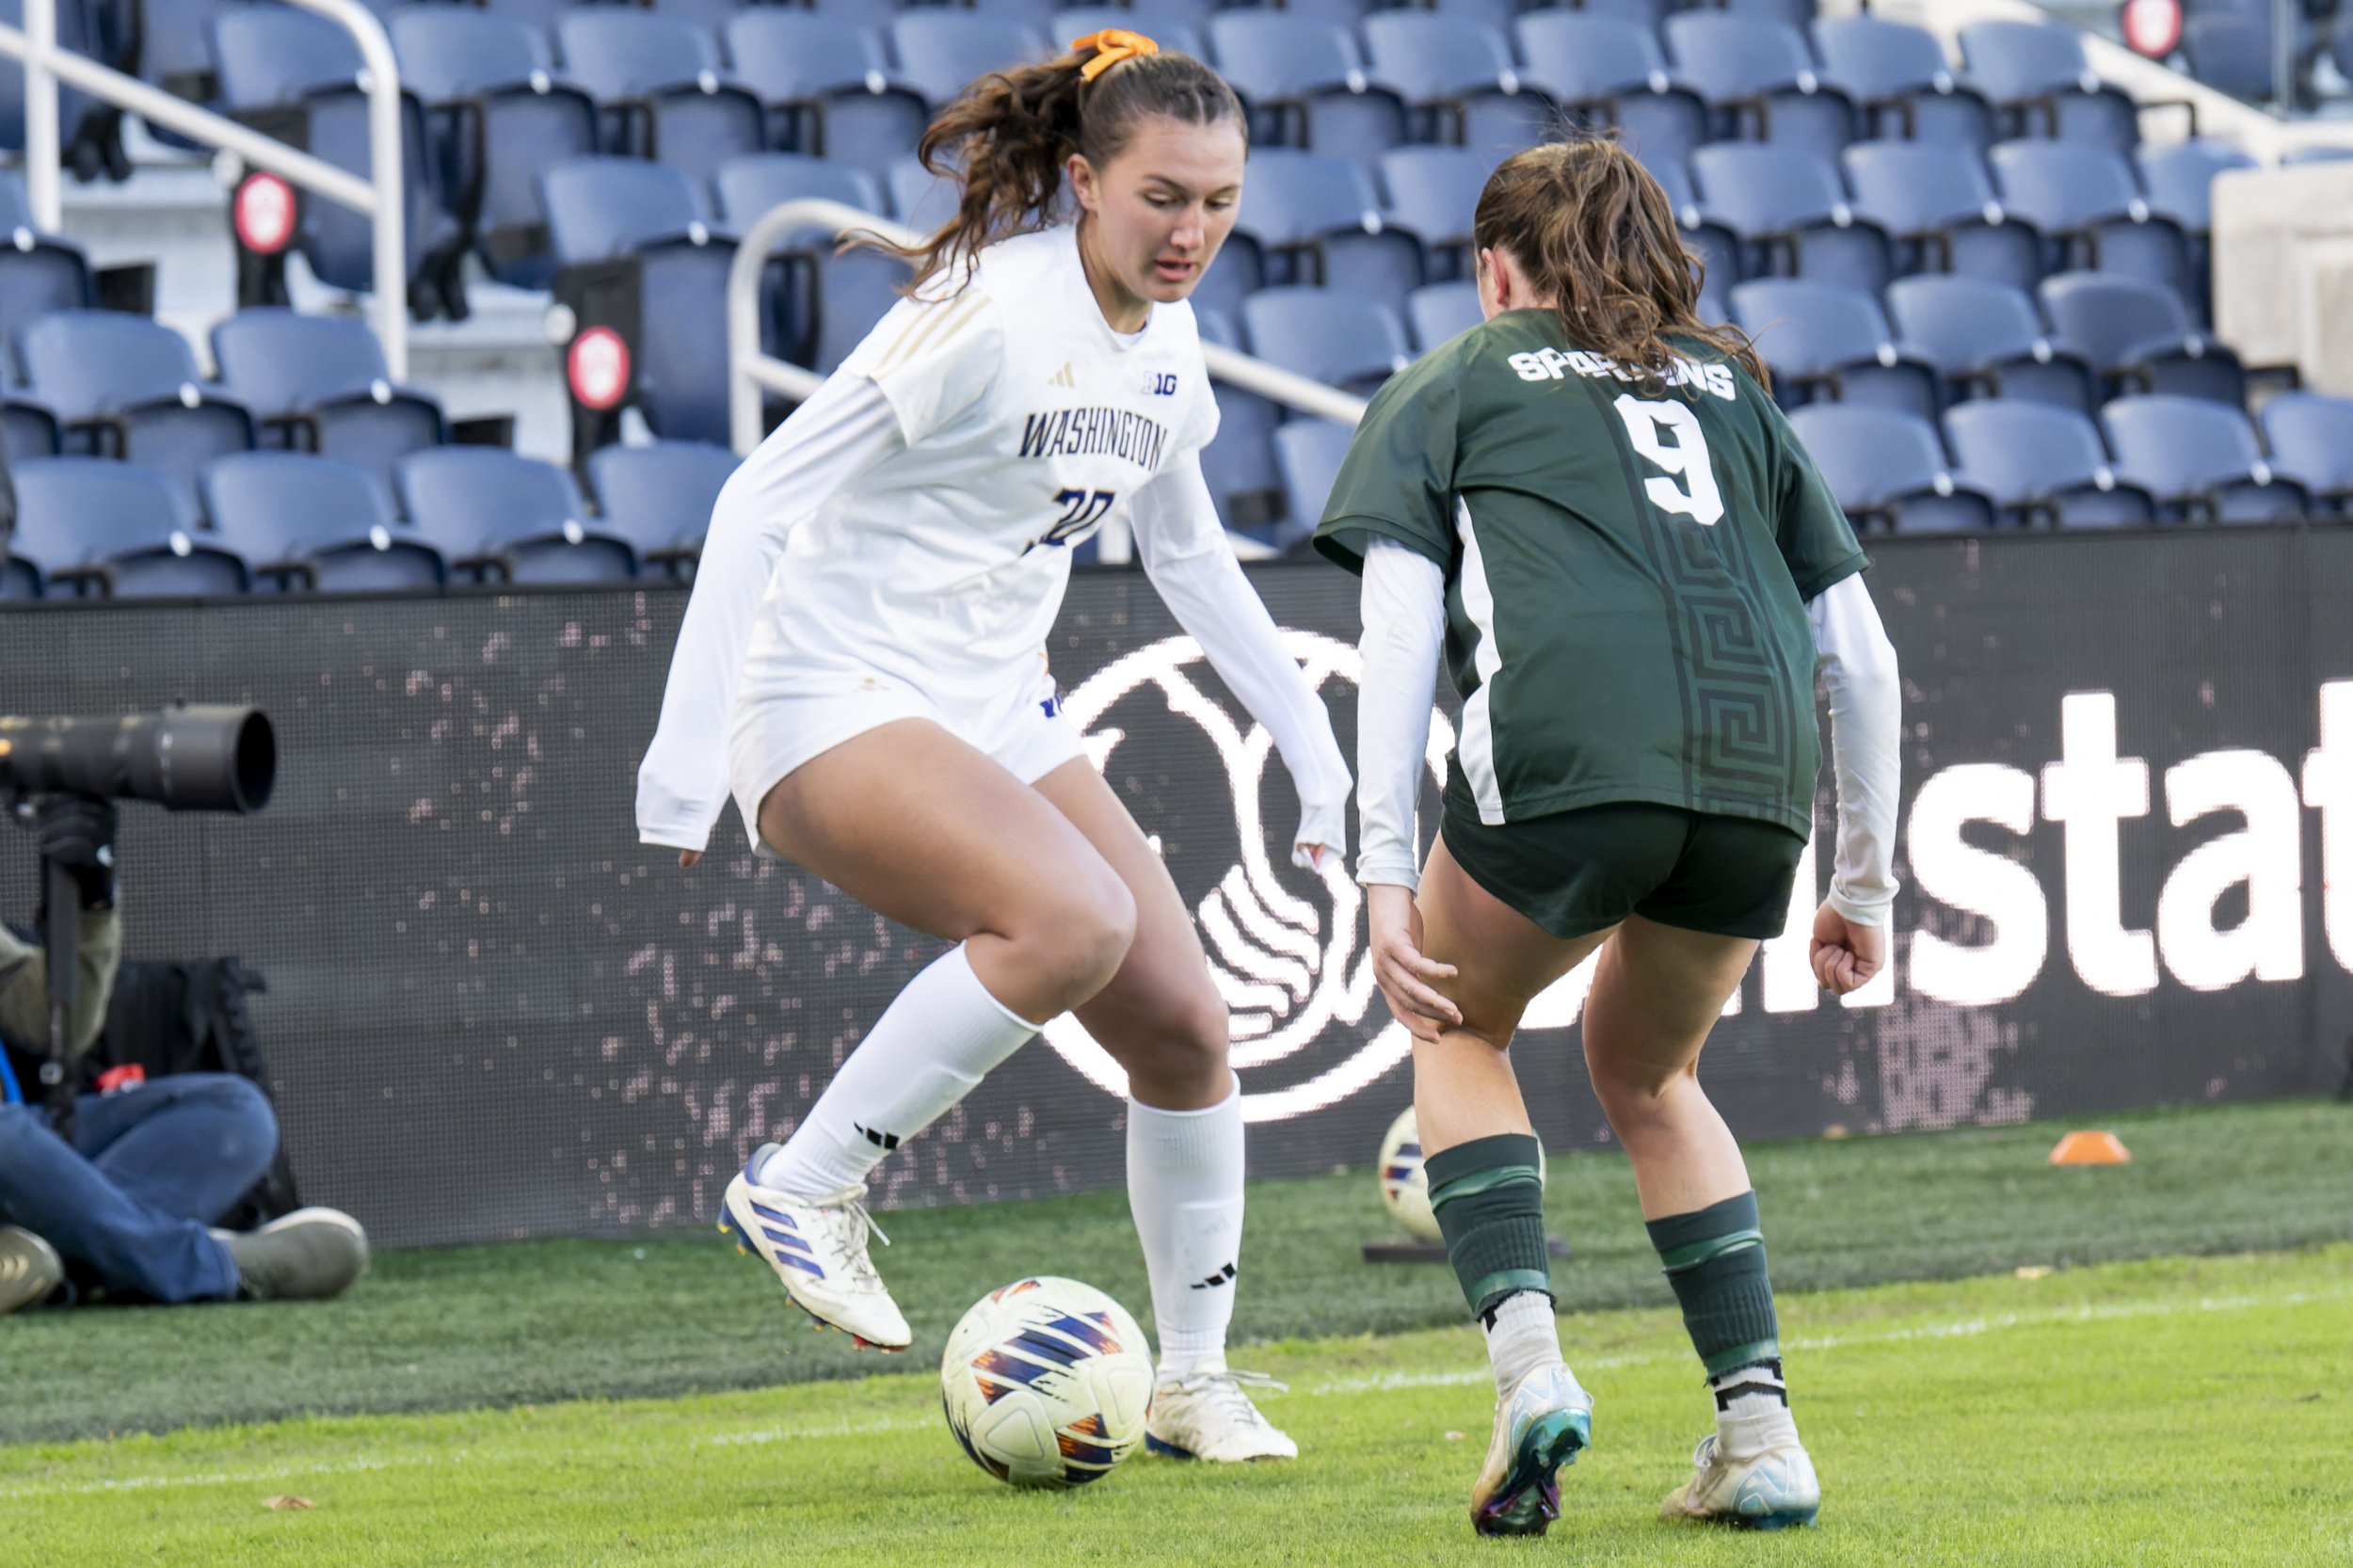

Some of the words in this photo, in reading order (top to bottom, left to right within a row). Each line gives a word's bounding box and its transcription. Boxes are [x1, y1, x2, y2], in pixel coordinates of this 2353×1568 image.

[1508, 346, 1737, 401] SPARNS
[1018, 407, 1168, 472] WASHINGTON
[1613, 393, 1724, 526] 9
